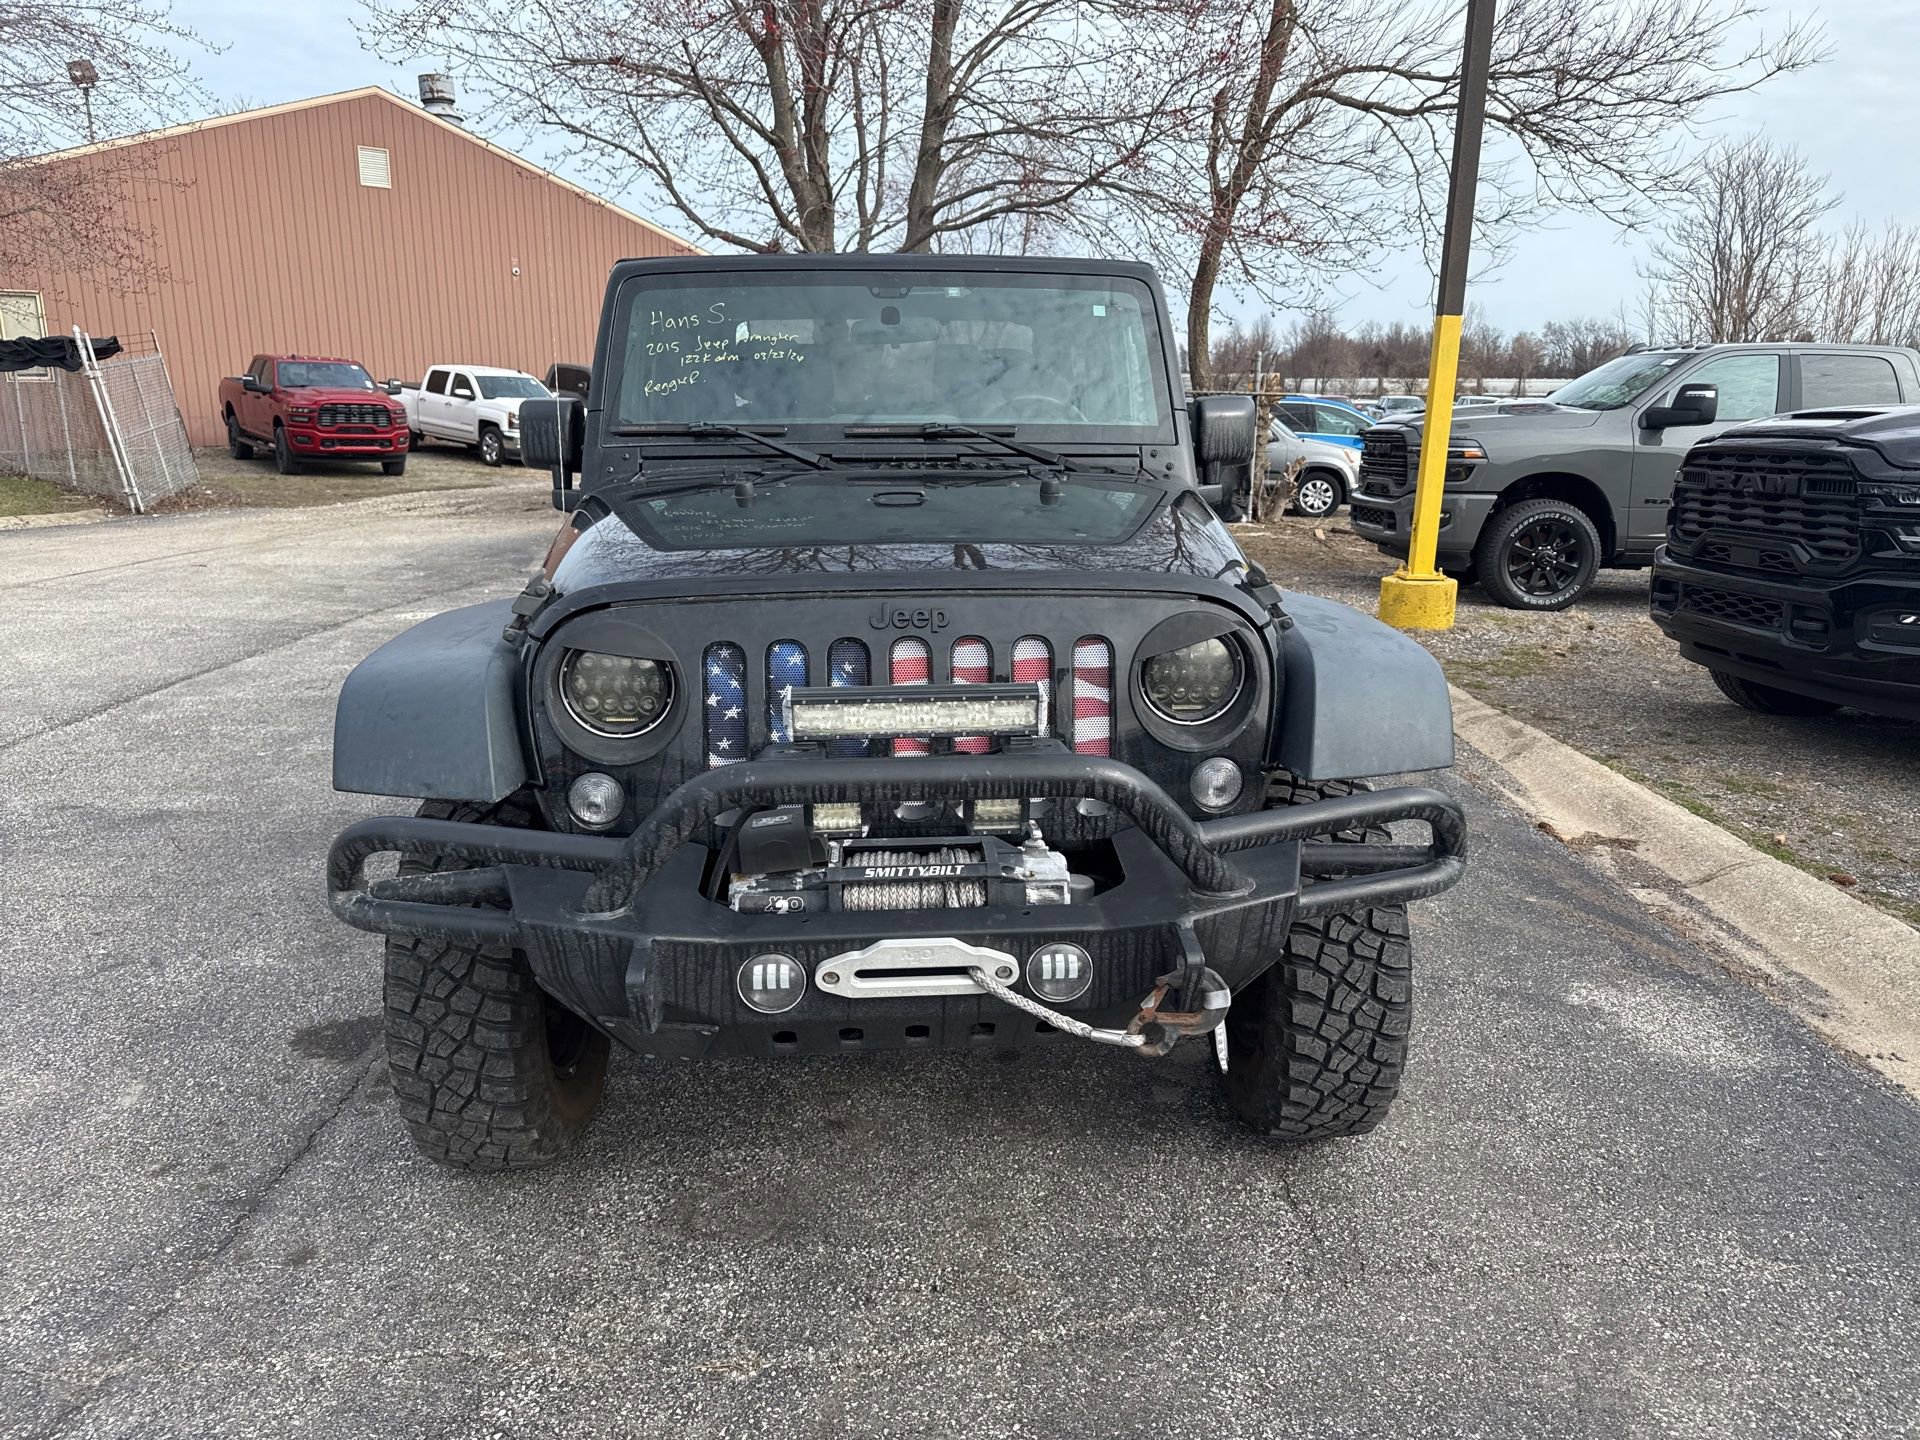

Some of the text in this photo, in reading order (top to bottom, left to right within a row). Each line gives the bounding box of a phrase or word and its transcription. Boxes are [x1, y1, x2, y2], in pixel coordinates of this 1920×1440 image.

[650, 302, 731, 332] Hans S.
[646, 341, 680, 355] 2015
[695, 335, 729, 351] Jeep
[1709, 470, 1800, 495] RAM
[869, 602, 949, 633] Jeep
[864, 864, 965, 878] SMITTYBILT
